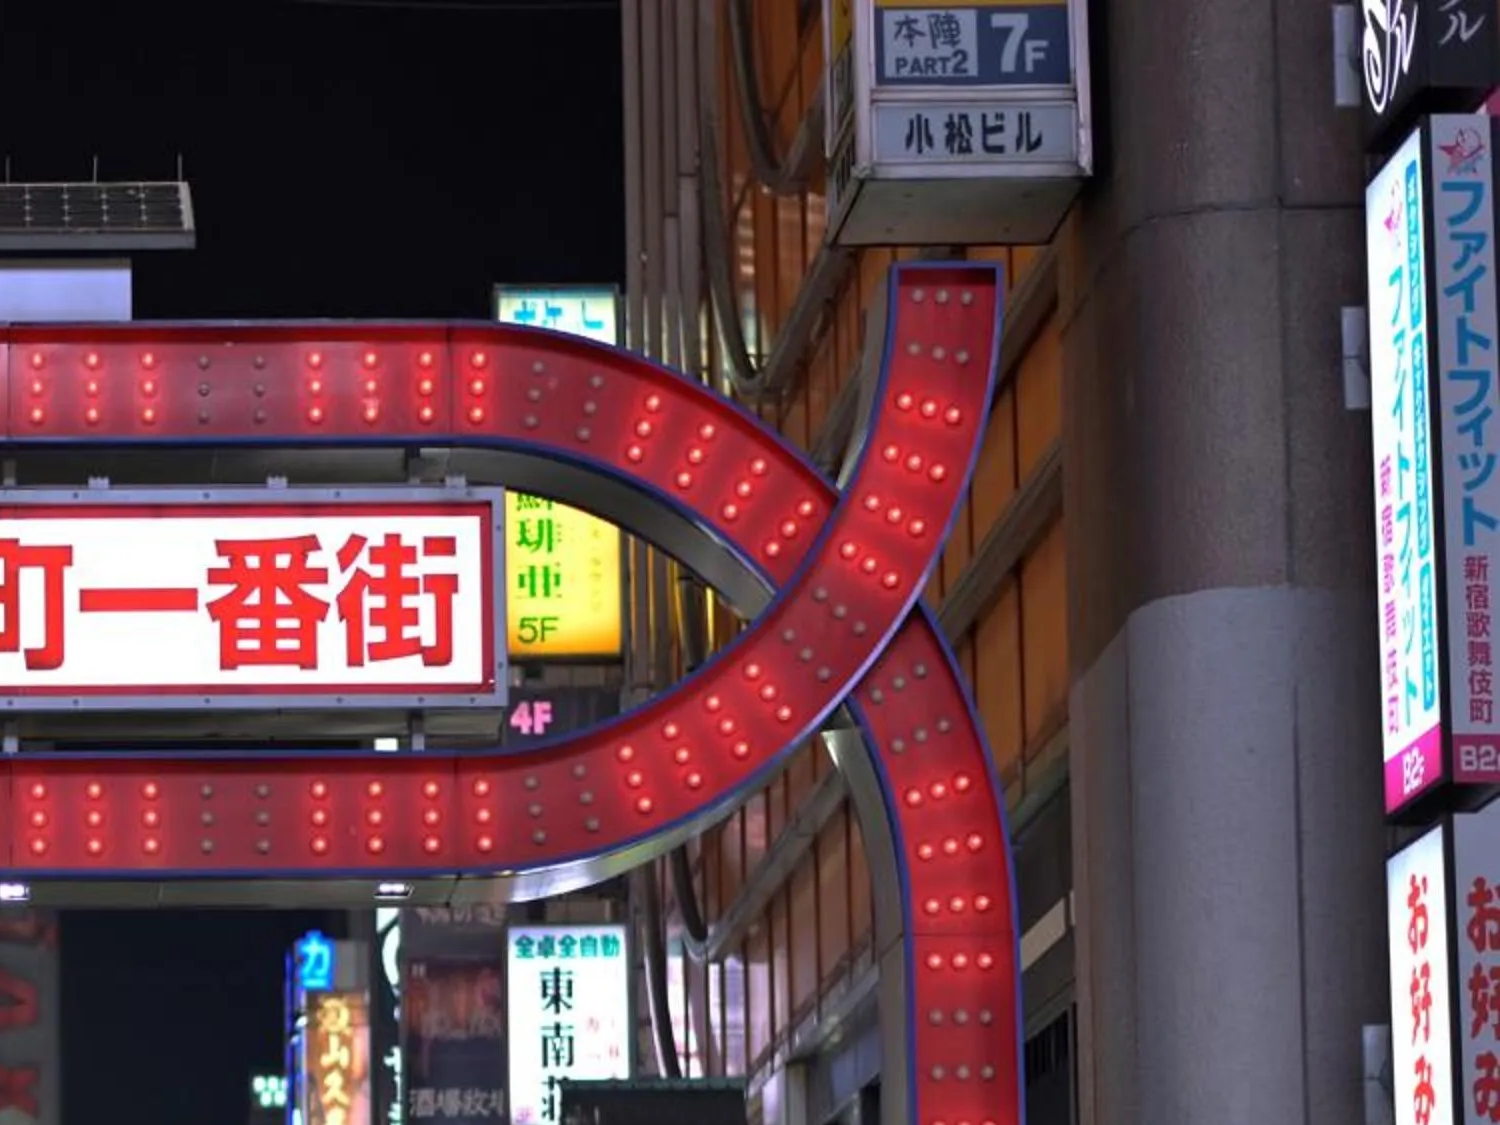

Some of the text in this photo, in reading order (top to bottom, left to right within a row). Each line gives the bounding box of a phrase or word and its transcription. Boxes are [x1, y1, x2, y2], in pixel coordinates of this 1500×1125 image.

[895, 13, 961, 48] 本陣
[894, 50, 968, 75] PART2
[905, 112, 1043, 154] 小松ビル
[1441, 180, 1499, 546] ファイトフィット
[517, 618, 560, 646] 5F
[1463, 555, 1493, 725] 新宿歌舞伎町
[510, 702, 553, 735] 4F
[514, 934, 620, 959] 全卓全自動
